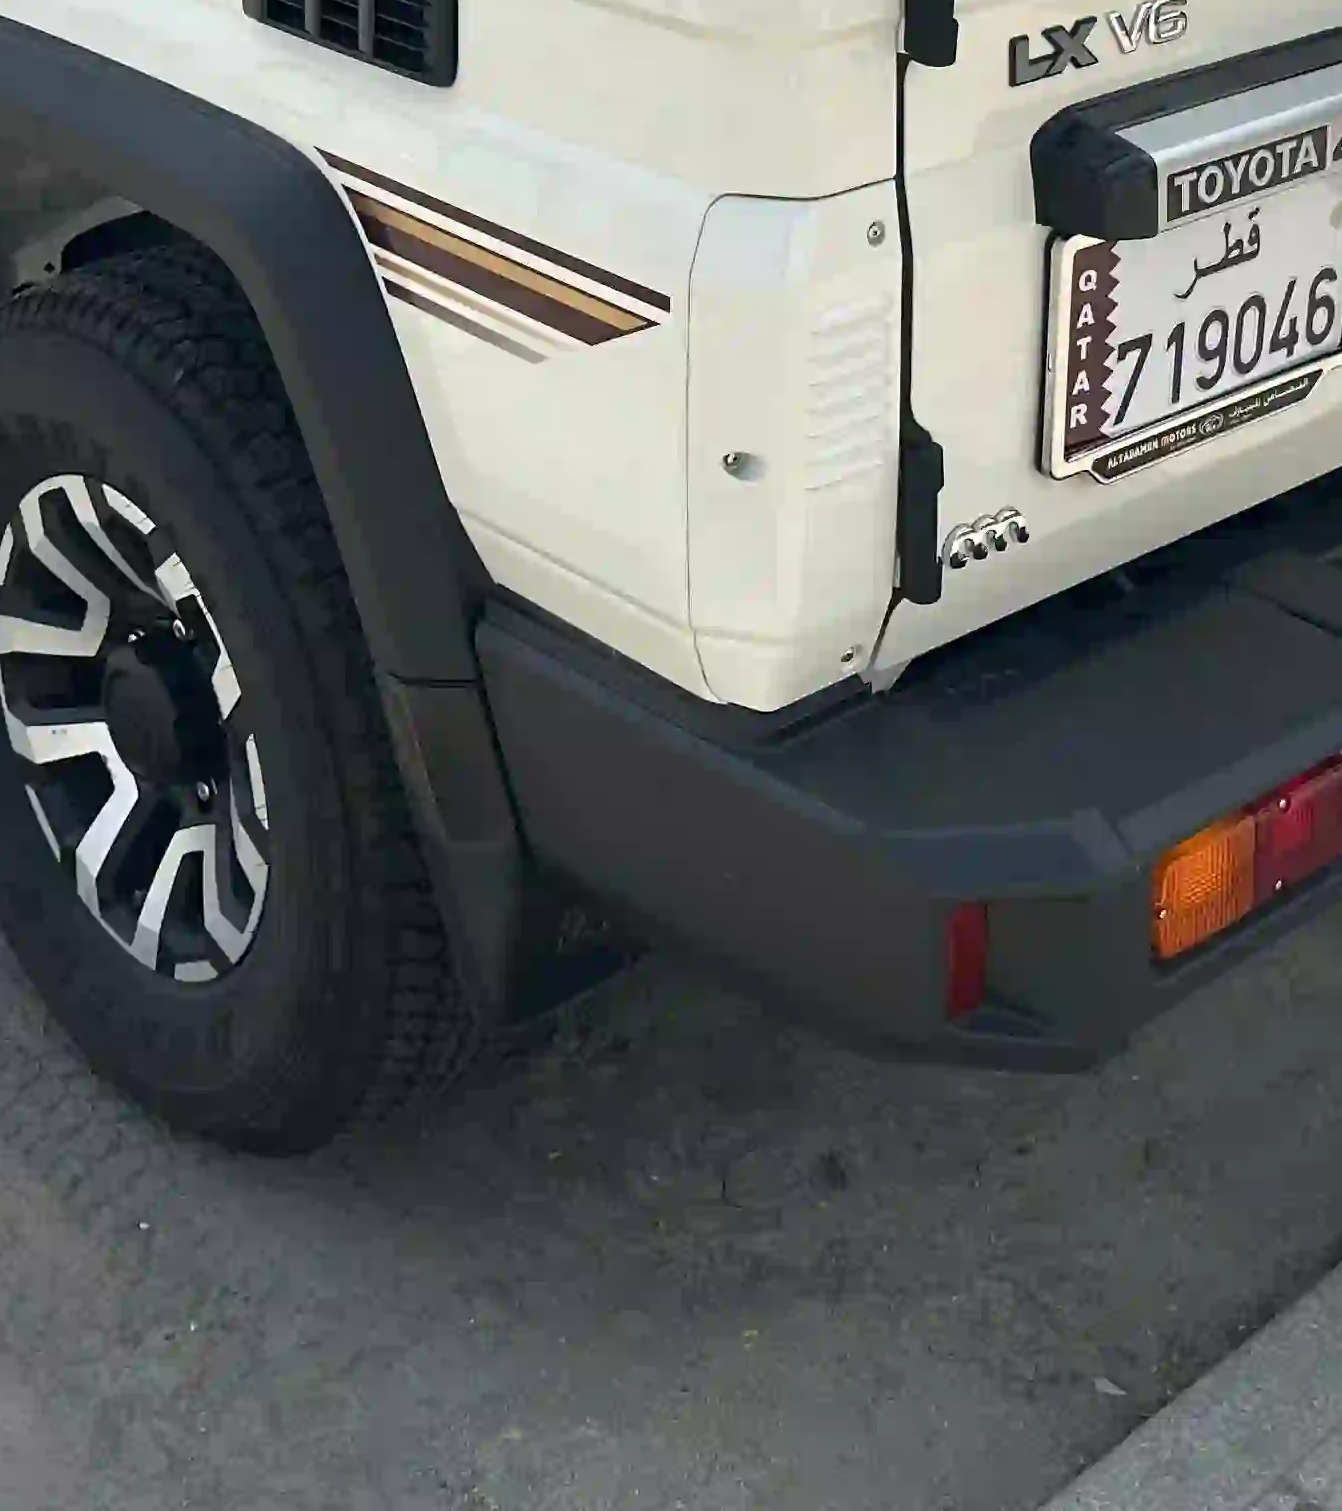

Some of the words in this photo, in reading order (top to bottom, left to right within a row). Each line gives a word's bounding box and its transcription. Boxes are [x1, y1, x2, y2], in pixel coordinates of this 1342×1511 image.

[1007, 15, 1100, 88] LX
[1172, 135, 1322, 214] TOYOTA
[1172, 206, 1261, 300] قطر
[1069, 267, 1098, 429] QATAR
[1112, 266, 1338, 427] 719046
